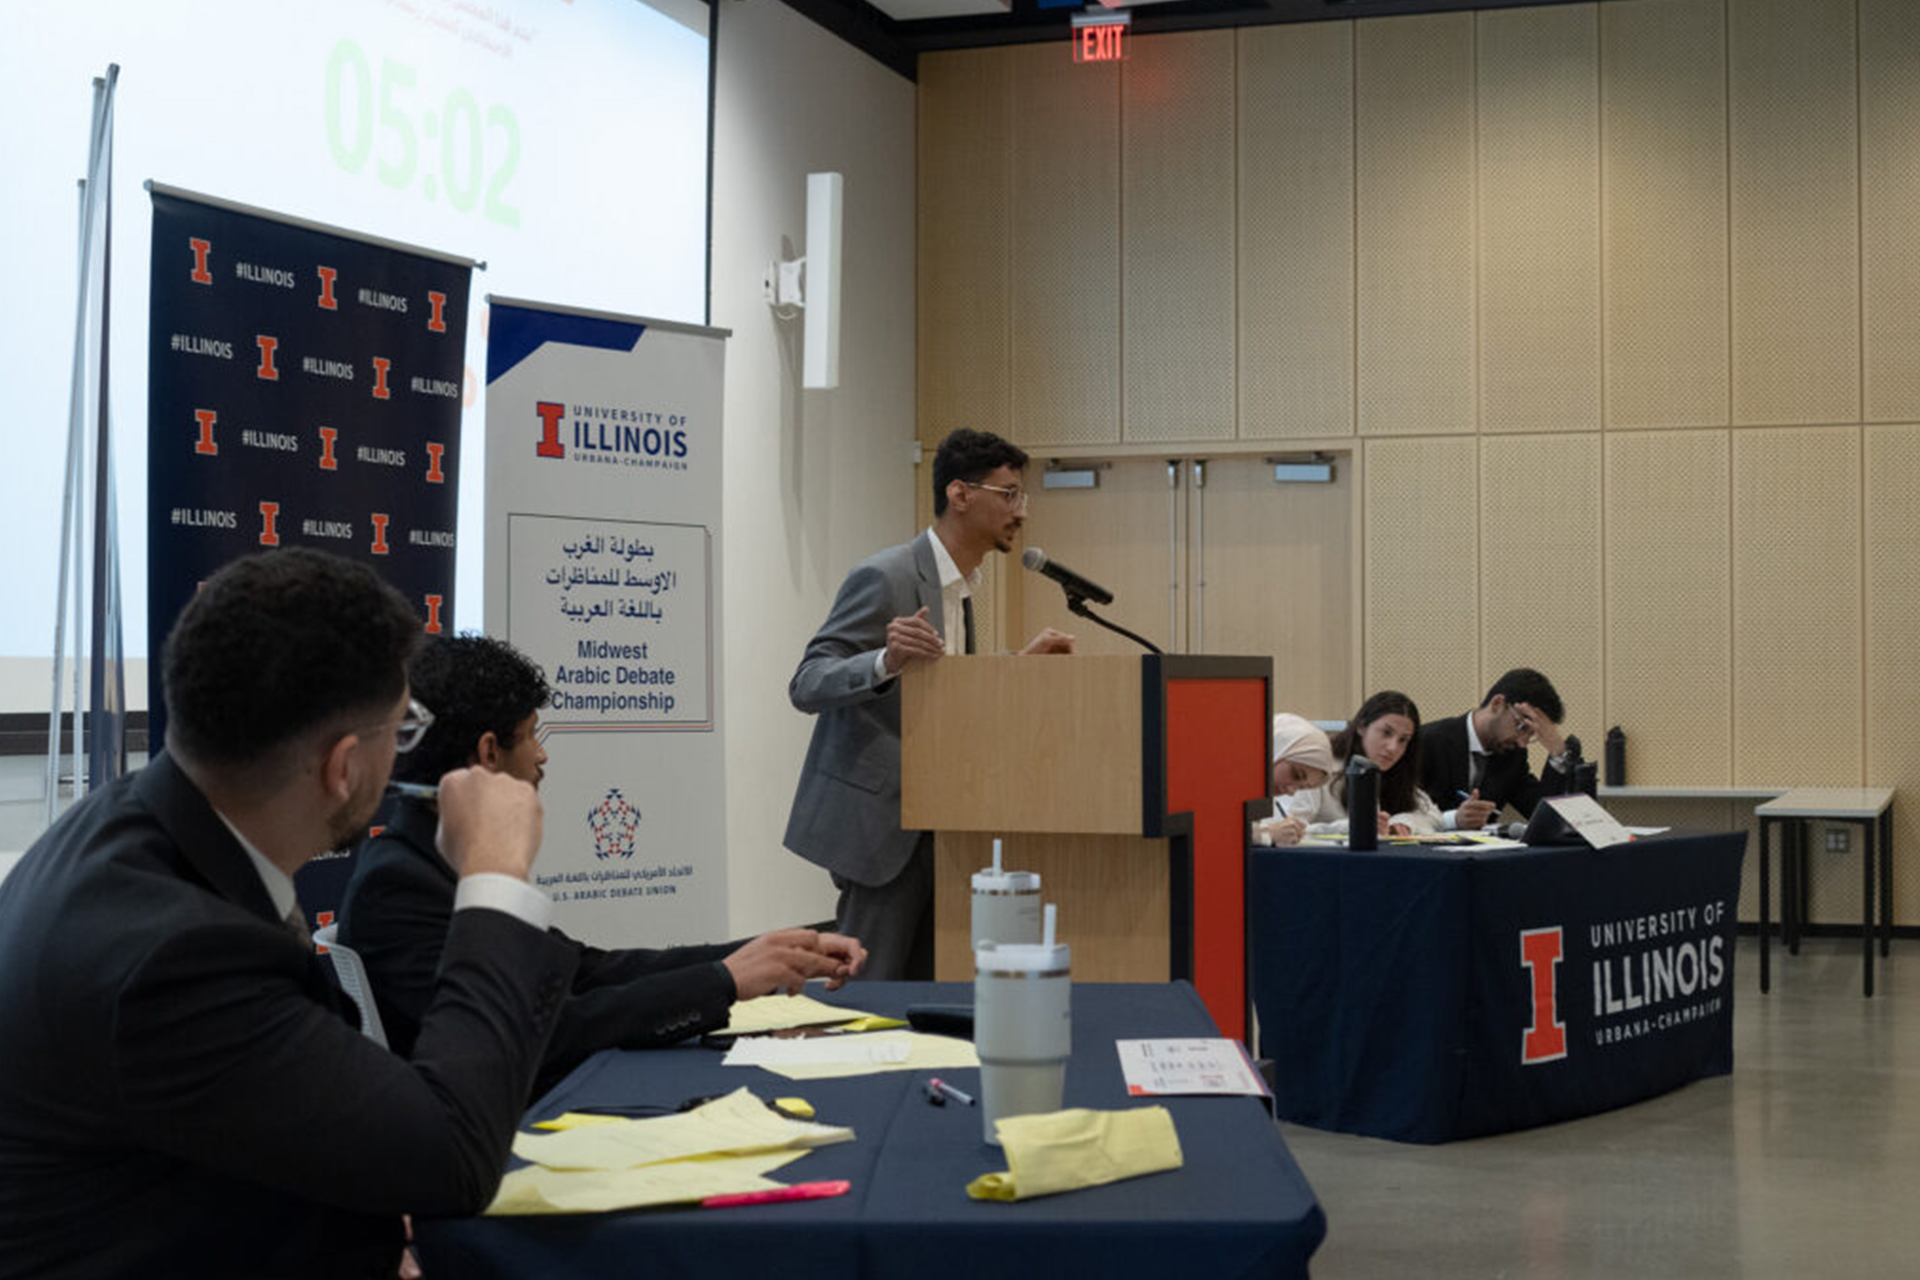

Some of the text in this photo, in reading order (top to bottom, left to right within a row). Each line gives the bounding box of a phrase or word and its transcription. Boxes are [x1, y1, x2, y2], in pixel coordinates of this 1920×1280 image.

[1083, 24, 1124, 61] EXIT
[324, 37, 523, 230] 05:02
[236, 263, 295, 288] #ILLINOIS
[358, 288, 408, 313] #ILLINOIS
[171, 334, 233, 359] #ILLINOIS
[303, 357, 353, 380] #ILLINOIS
[411, 377, 458, 397] #ILLINOIS
[573, 405, 687, 426] UNIVERSITY OF
[242, 430, 298, 452] #ILLINOIS
[357, 446, 405, 467] #ILLINOIS
[574, 421, 688, 458] ILLINOIS
[574, 452, 688, 471] URBANA-CHAMPAIGN
[171, 508, 237, 529] #ILLINOIS
[303, 519, 352, 539] #ILLINOIS
[409, 529, 456, 548] #ILLINOIS
[563, 534, 654, 562] بطولة الغرب
[546, 566, 620, 591] للمناظرات
[560, 596, 662, 625] باللغة العربية
[578, 640, 648, 659] Midwest
[555, 665, 675, 684] Arabic Debate
[551, 691, 675, 713] Championship
[574, 888, 607, 900] ARABIC
[610, 886, 643, 898] DEBATE
[646, 884, 676, 896] UNION
[1591, 901, 1724, 948] UNIVERSITY OF
[1594, 935, 1724, 1016] ILLINOIS
[1520, 925, 1567, 1065] I
[1596, 997, 1721, 1046] URBANA-CHAMPAIGN
